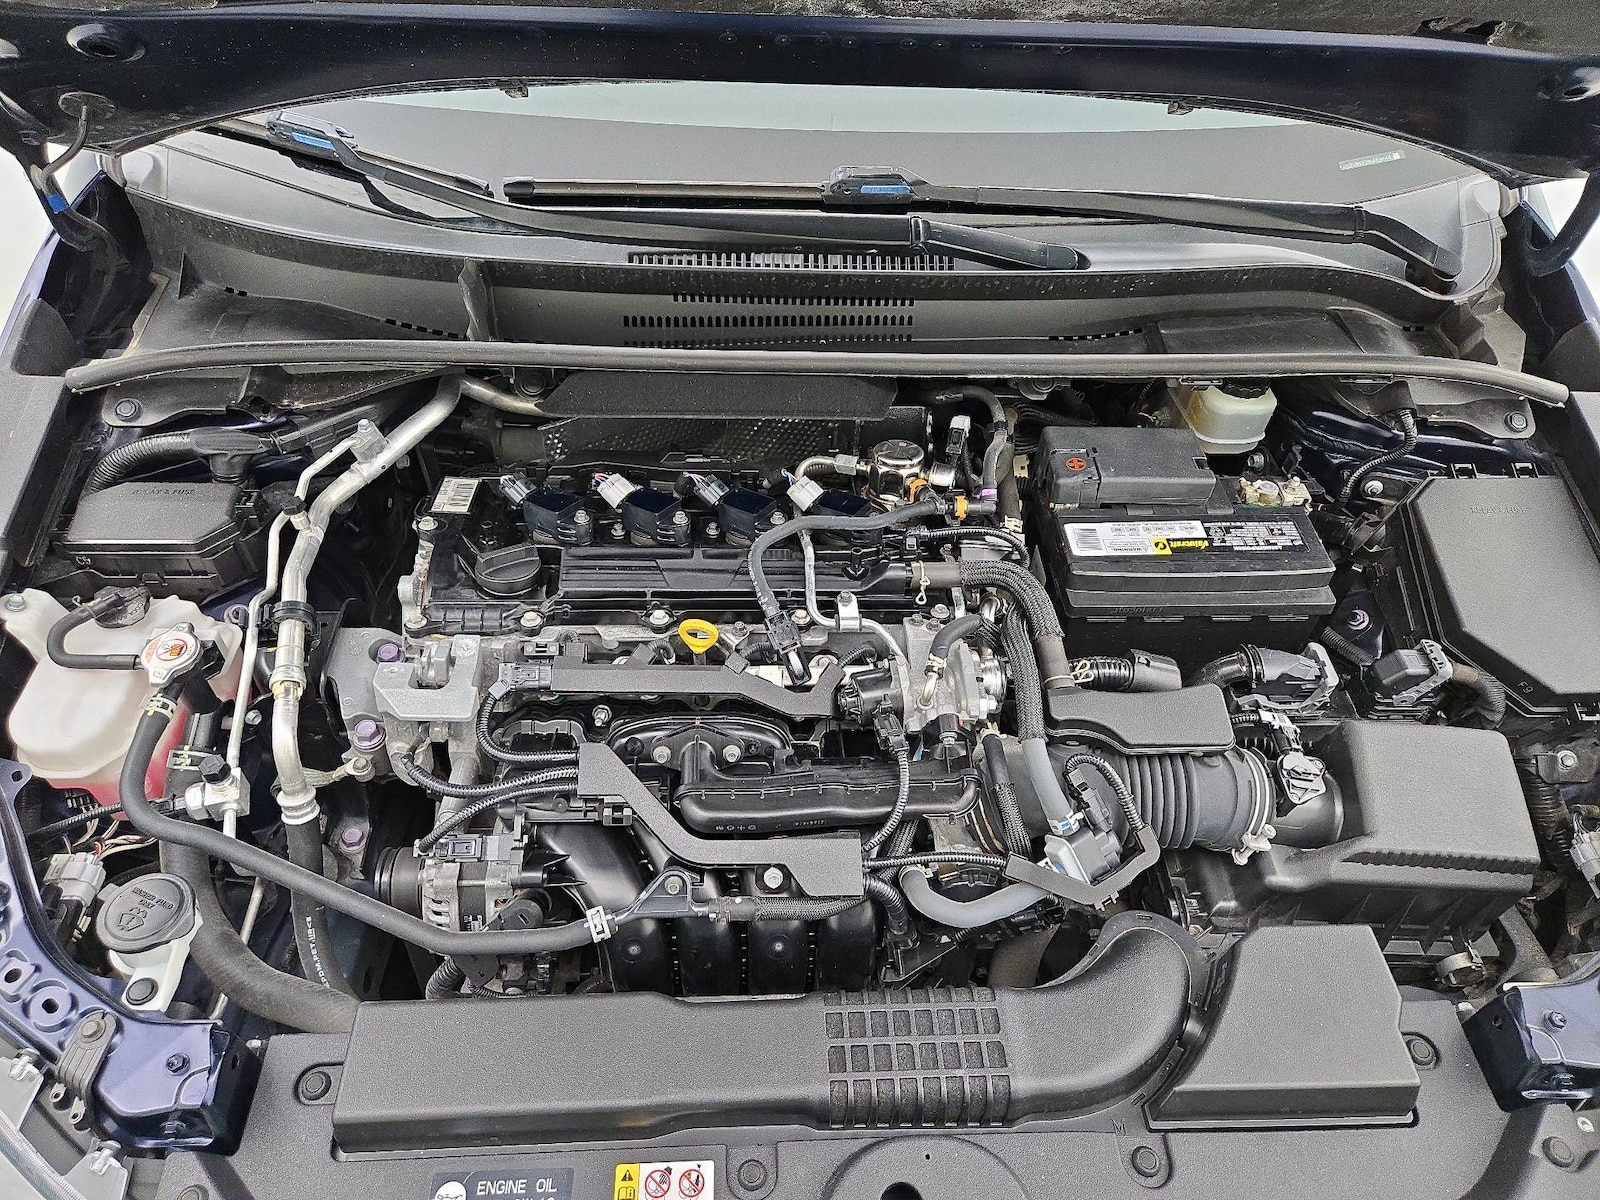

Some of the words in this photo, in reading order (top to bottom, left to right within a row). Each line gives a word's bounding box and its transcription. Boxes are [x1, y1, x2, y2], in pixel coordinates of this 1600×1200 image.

[1169, 540, 1209, 550] Valucraft
[1517, 681, 1534, 694] F9
[476, 1179, 528, 1195] ENGINE
[536, 1178, 558, 1193] OIL
